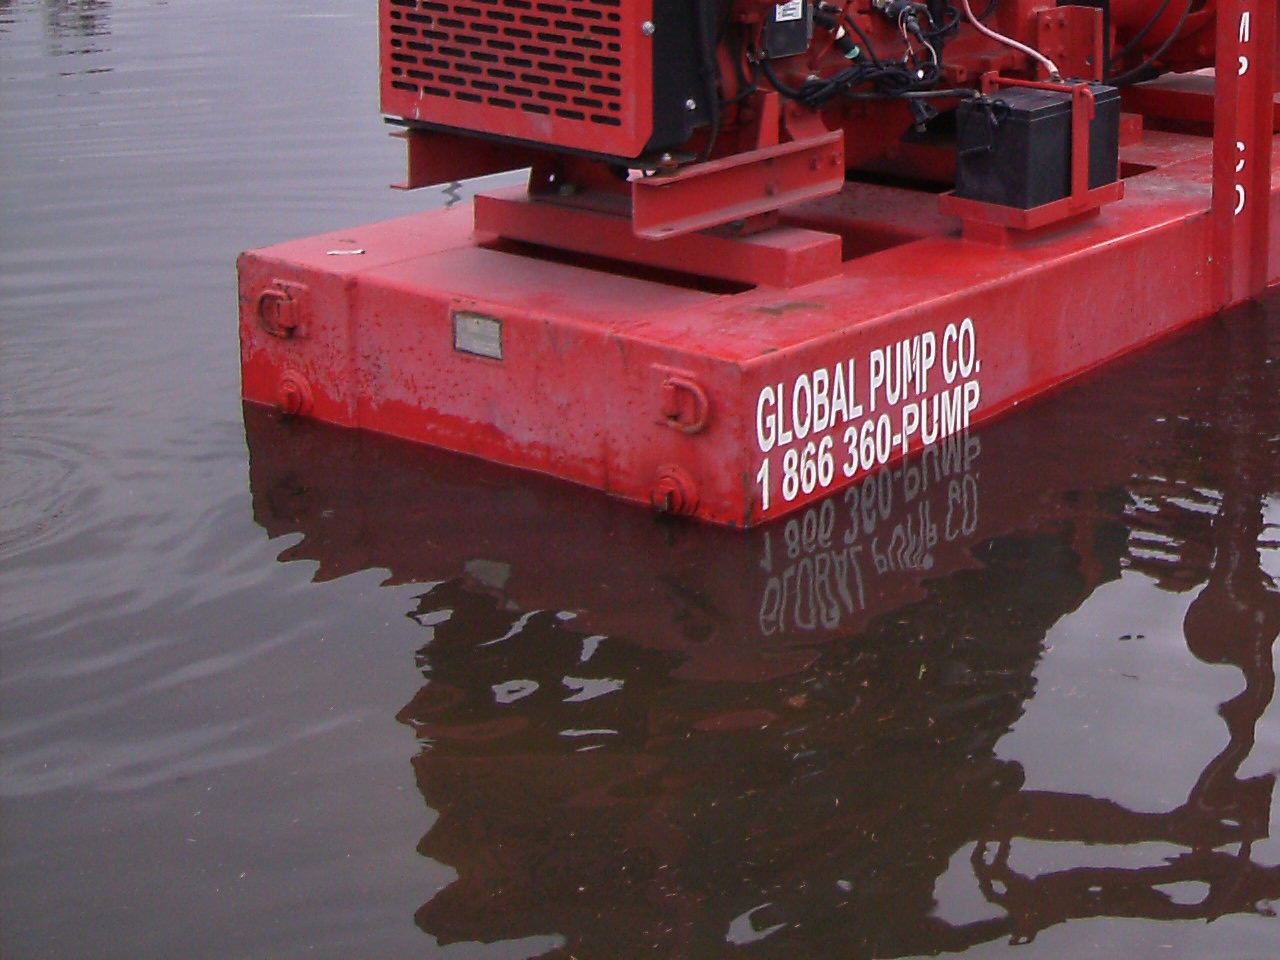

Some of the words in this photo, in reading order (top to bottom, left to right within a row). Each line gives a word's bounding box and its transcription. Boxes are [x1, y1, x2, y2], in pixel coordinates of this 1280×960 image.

[756, 358, 864, 453] GLOBAL
[869, 331, 936, 412] PUMP
[942, 317, 982, 384] CO.
[756, 457, 770, 511] 1
[782, 435, 834, 502] 866
[842, 380, 981, 479] 360-PUMP
